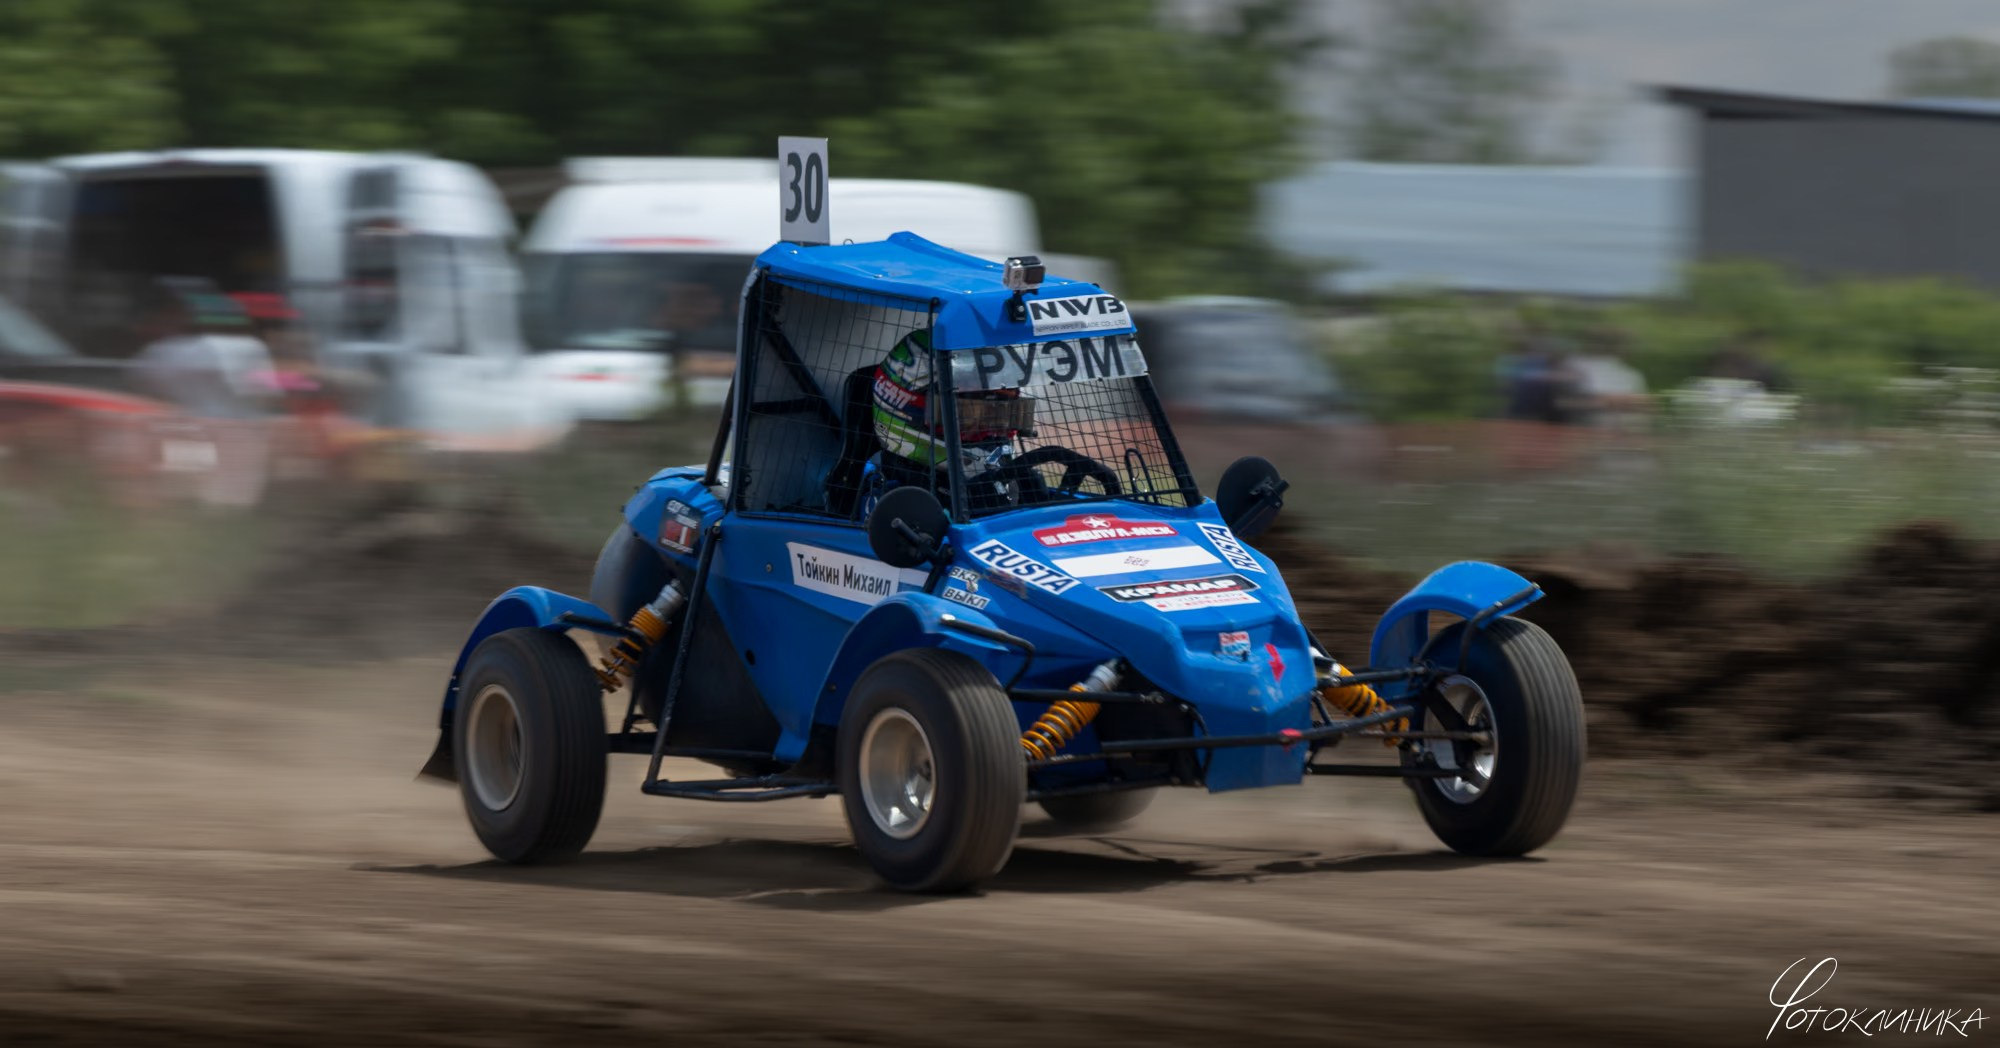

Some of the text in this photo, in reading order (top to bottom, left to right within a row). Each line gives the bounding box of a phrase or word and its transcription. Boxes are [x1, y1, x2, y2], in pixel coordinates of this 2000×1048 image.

[785, 152, 823, 224] 30
[1029, 296, 1125, 321] NWB
[973, 335, 1125, 389] РУЭМ
[974, 544, 1075, 592] RUSTA
[1202, 526, 1262, 572] RUSTA
[797, 553, 891, 597] Тойкин Михаил
[1115, 578, 1236, 599] КРАМАР
[944, 588, 987, 608] ВЫКЛ
